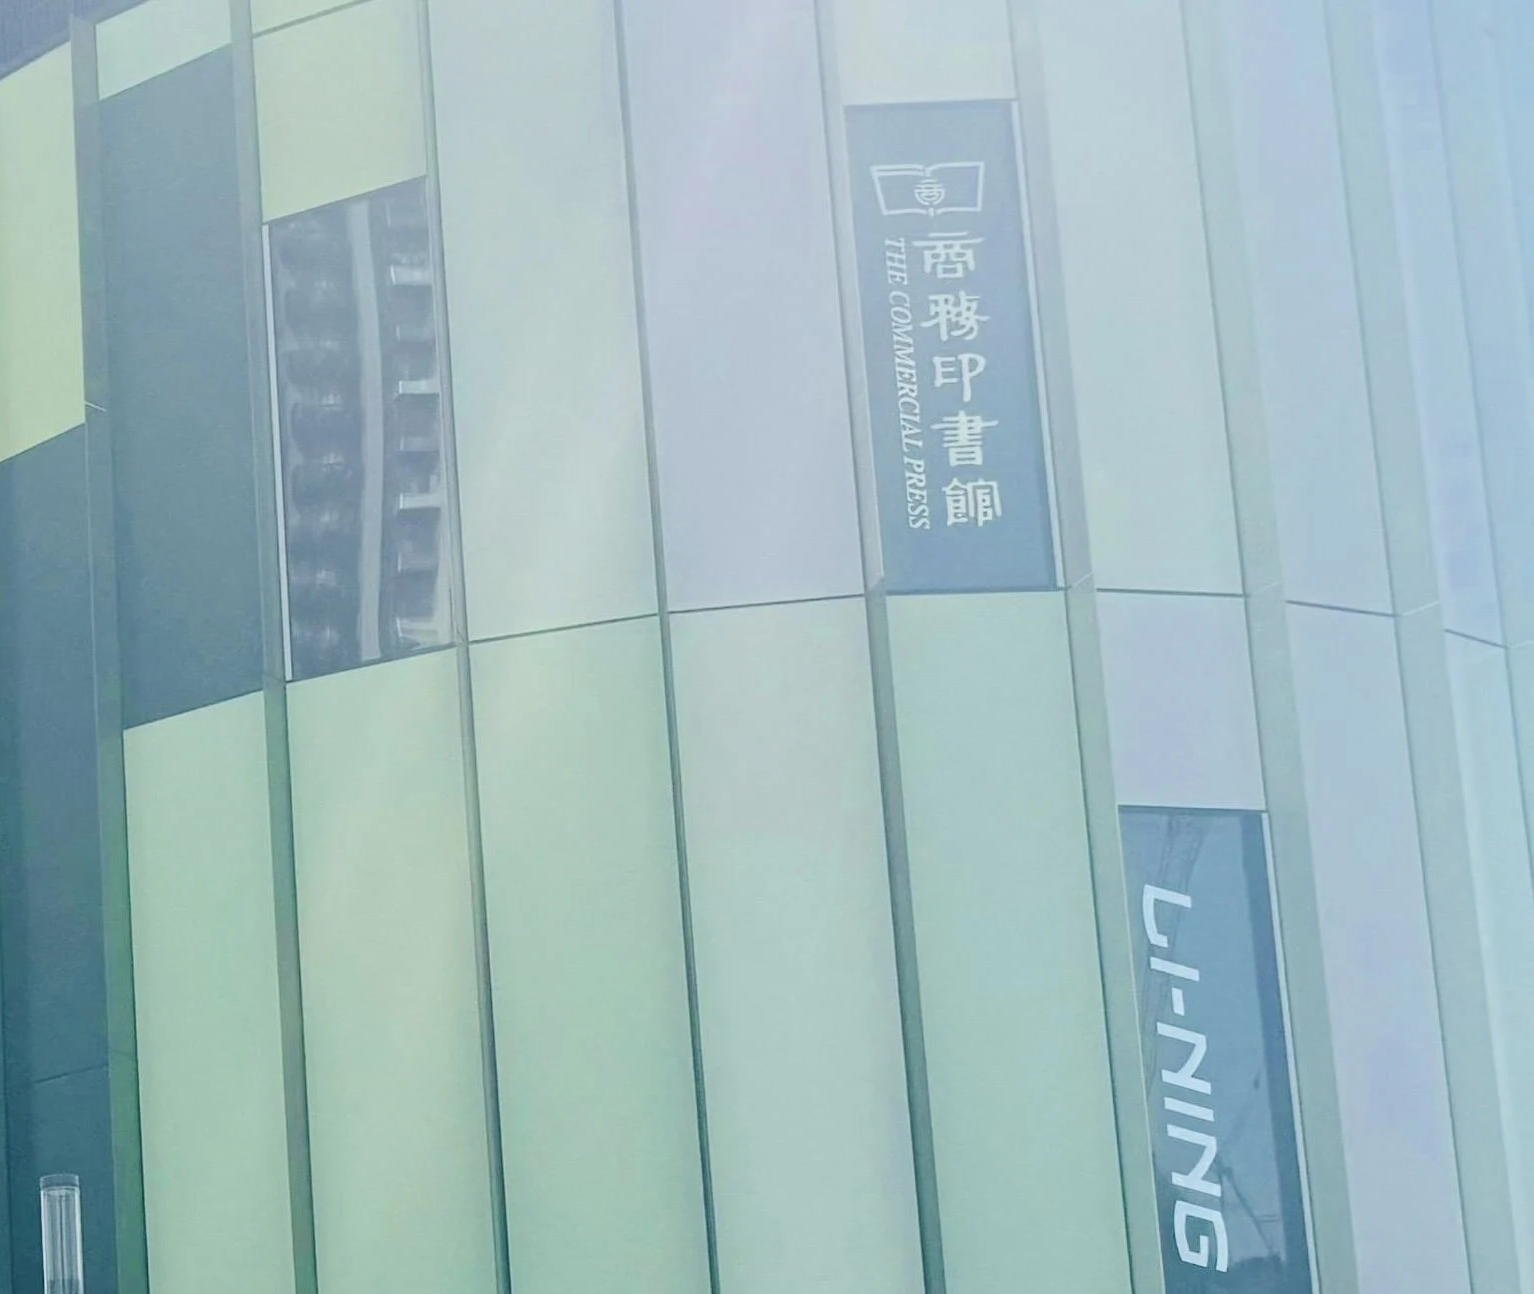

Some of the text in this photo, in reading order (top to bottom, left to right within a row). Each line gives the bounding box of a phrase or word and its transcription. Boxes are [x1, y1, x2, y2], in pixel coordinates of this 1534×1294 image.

[884, 237, 930, 530] THE COMMERCIAL PRESS
[912, 231, 1003, 527] 商務印書館
[1142, 883, 1228, 1273] LI-NING
